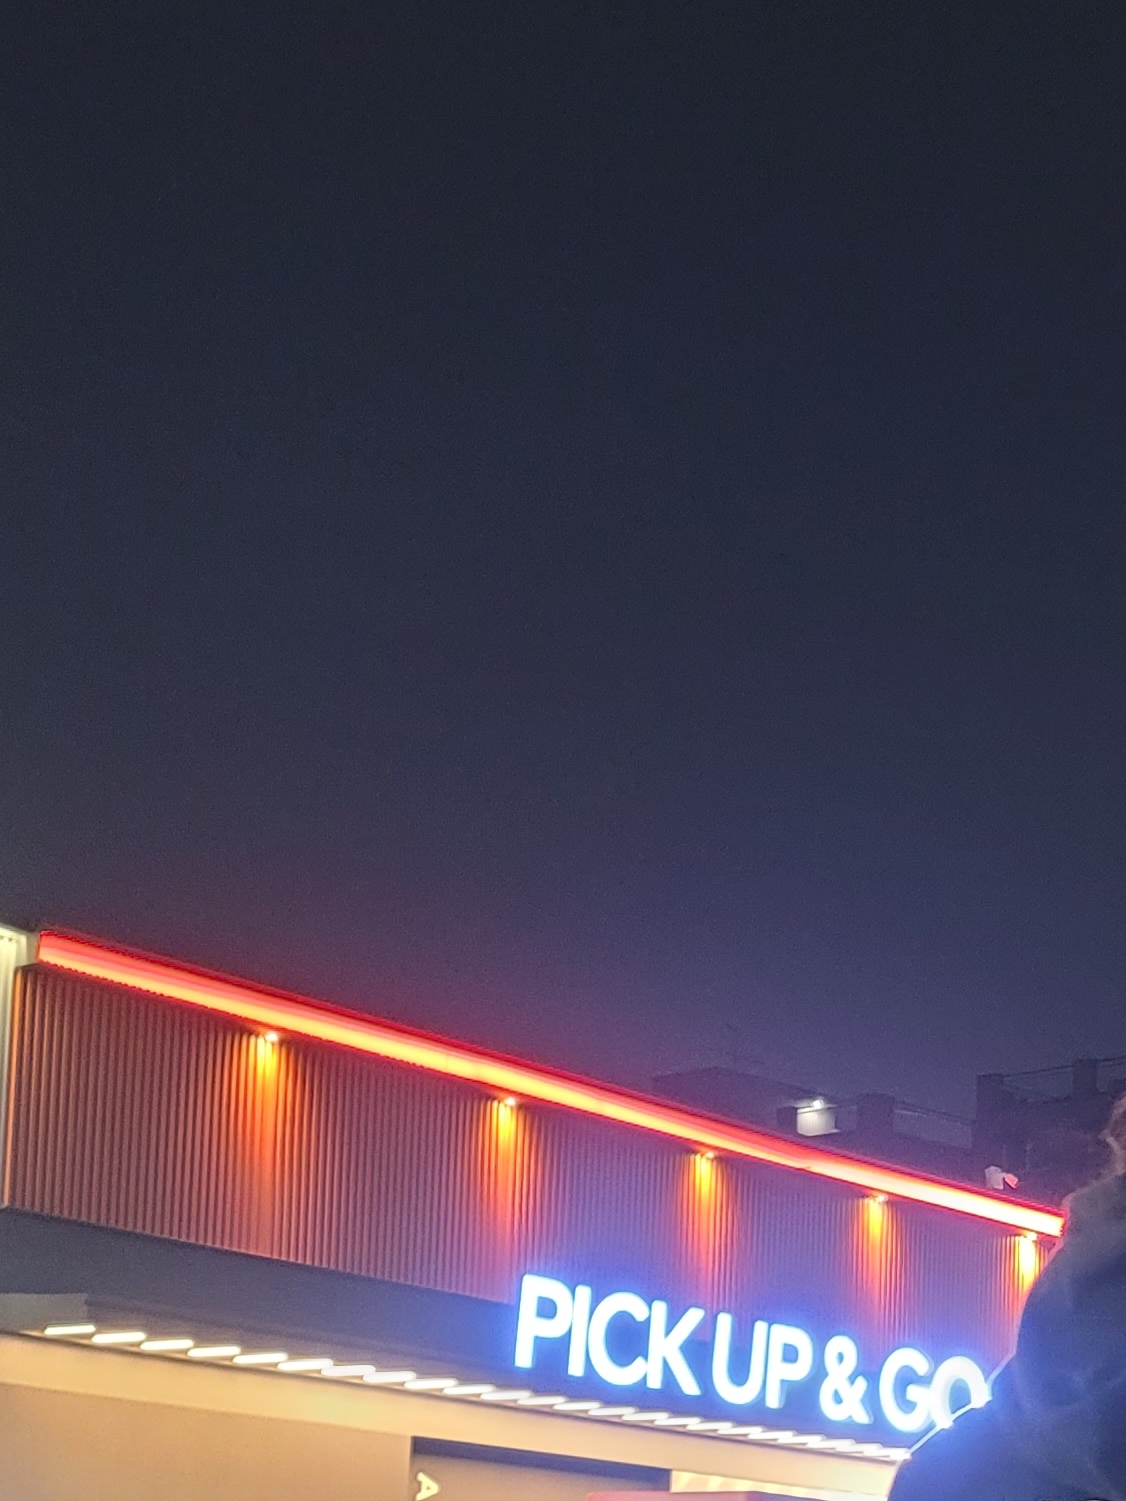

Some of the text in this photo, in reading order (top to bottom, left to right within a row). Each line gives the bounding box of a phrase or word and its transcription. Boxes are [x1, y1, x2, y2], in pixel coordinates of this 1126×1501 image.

[514, 1273, 705, 1396] PICK
[711, 1311, 814, 1409] UP
[879, 1346, 992, 1432] GO
[415, 1471, 442, 1501] A
